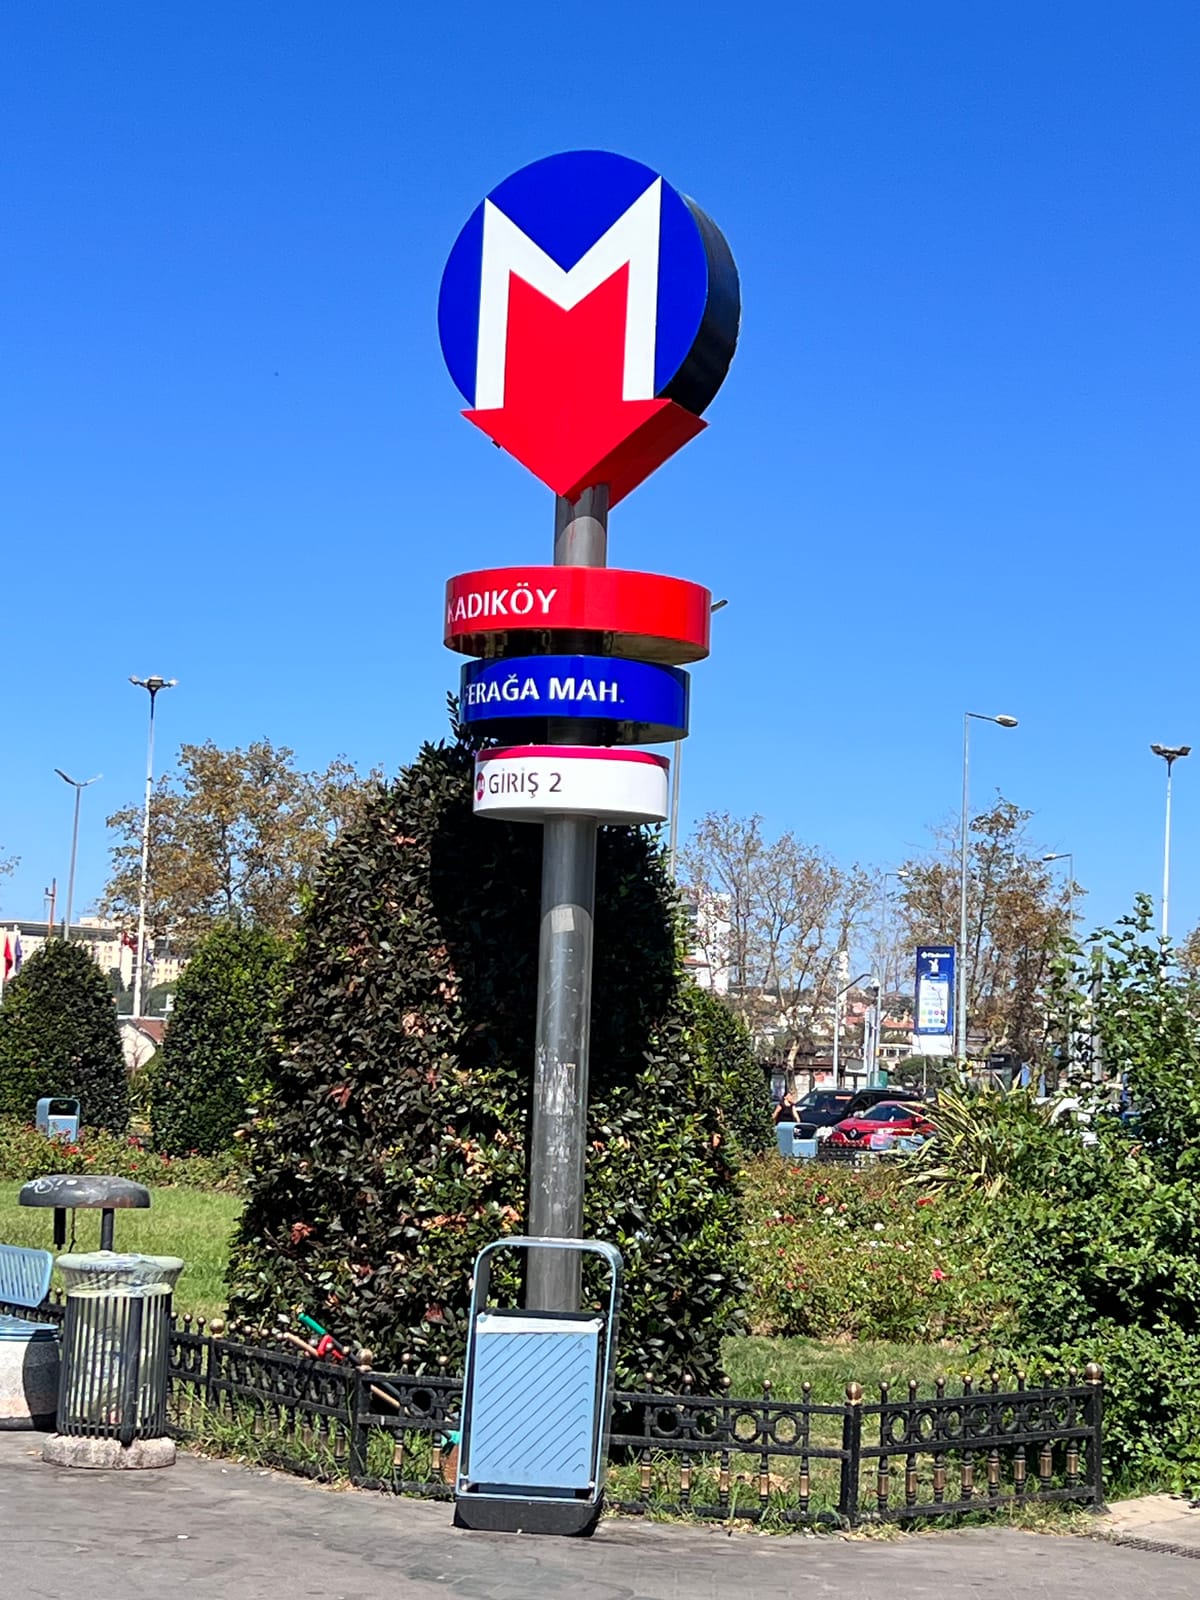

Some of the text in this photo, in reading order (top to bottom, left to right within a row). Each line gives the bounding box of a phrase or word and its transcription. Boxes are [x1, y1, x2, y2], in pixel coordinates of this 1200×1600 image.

[475, 174, 662, 411] M
[447, 582, 558, 625] KADIKÖY
[549, 677, 625, 704] MAH.
[488, 766, 539, 799] GİRİŞ
[549, 772, 562, 793] 2
